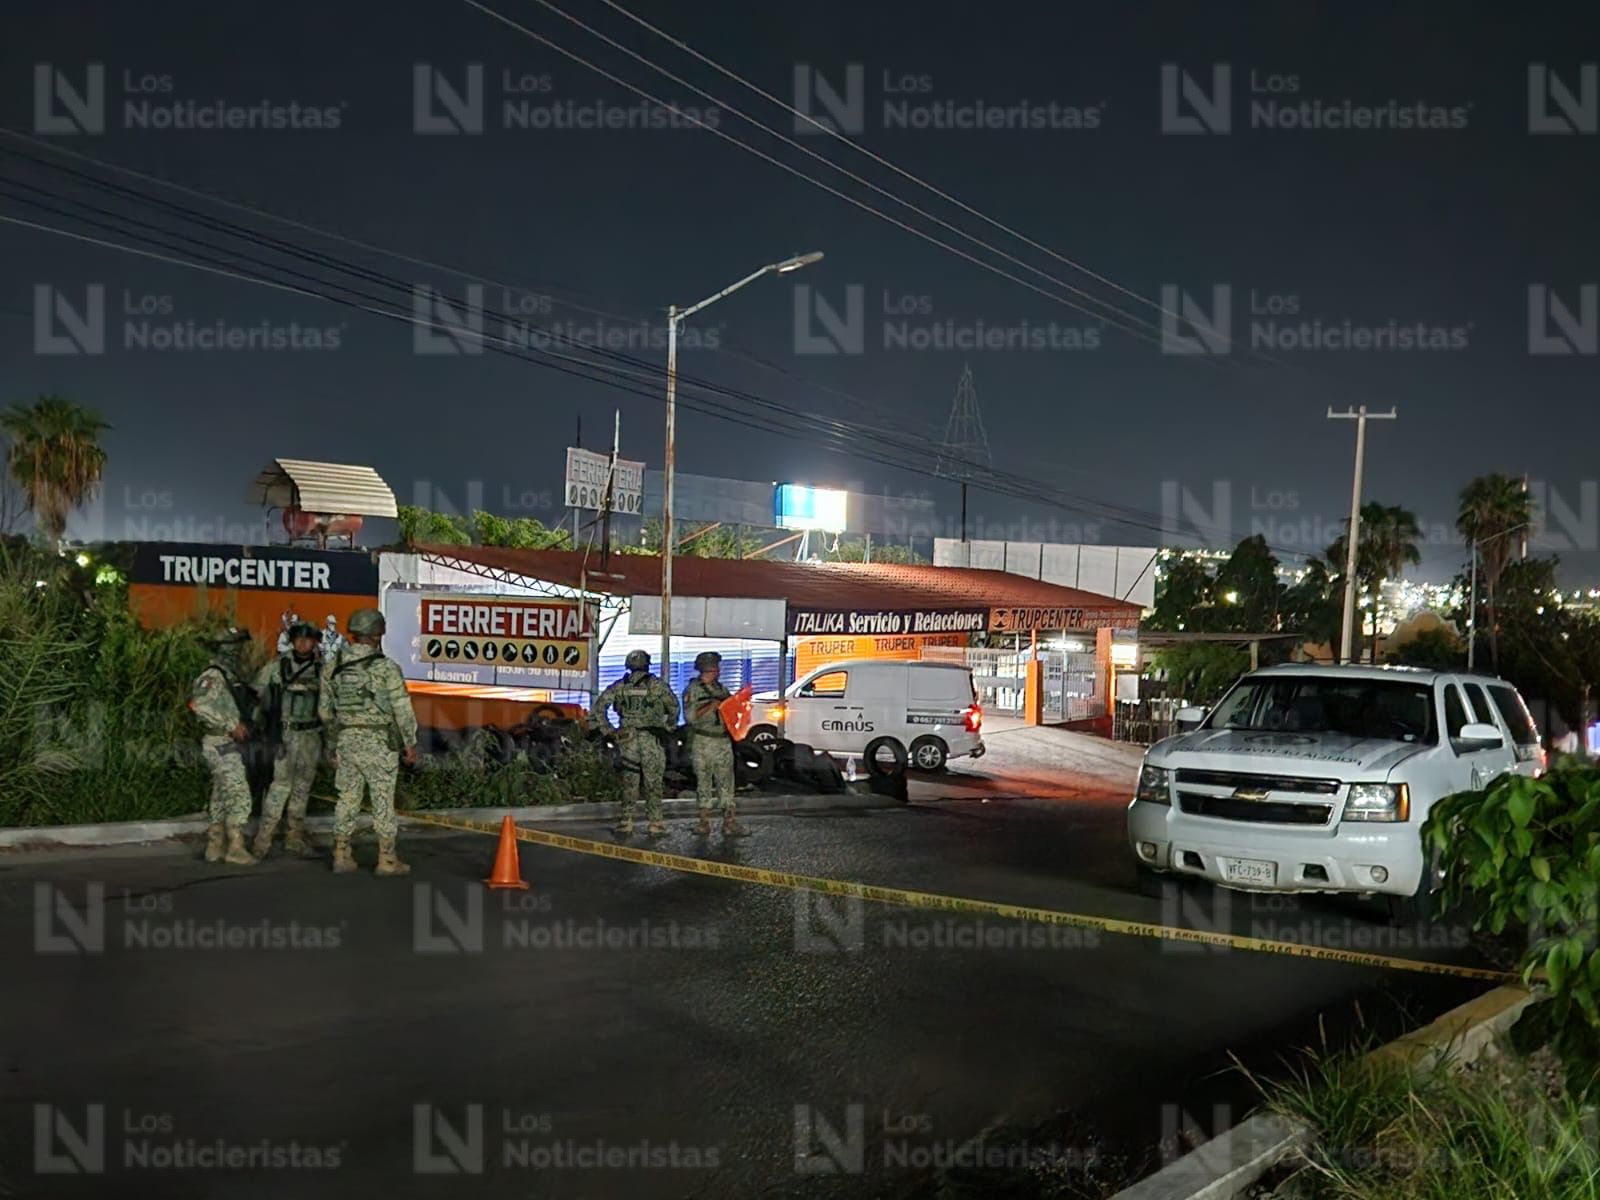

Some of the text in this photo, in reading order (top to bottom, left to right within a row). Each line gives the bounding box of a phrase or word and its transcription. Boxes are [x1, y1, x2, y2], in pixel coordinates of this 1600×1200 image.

[160, 555, 330, 589] TRUPCENTER
[428, 603, 580, 637] FERRETERIA
[794, 610, 983, 634] ITALIKA Servicio y Refacciones
[1011, 608, 1083, 629] TRUPCENTER
[809, 640, 855, 655] TRUPER
[874, 637, 915, 652] TRUPER
[922, 635, 958, 647] TRUPER
